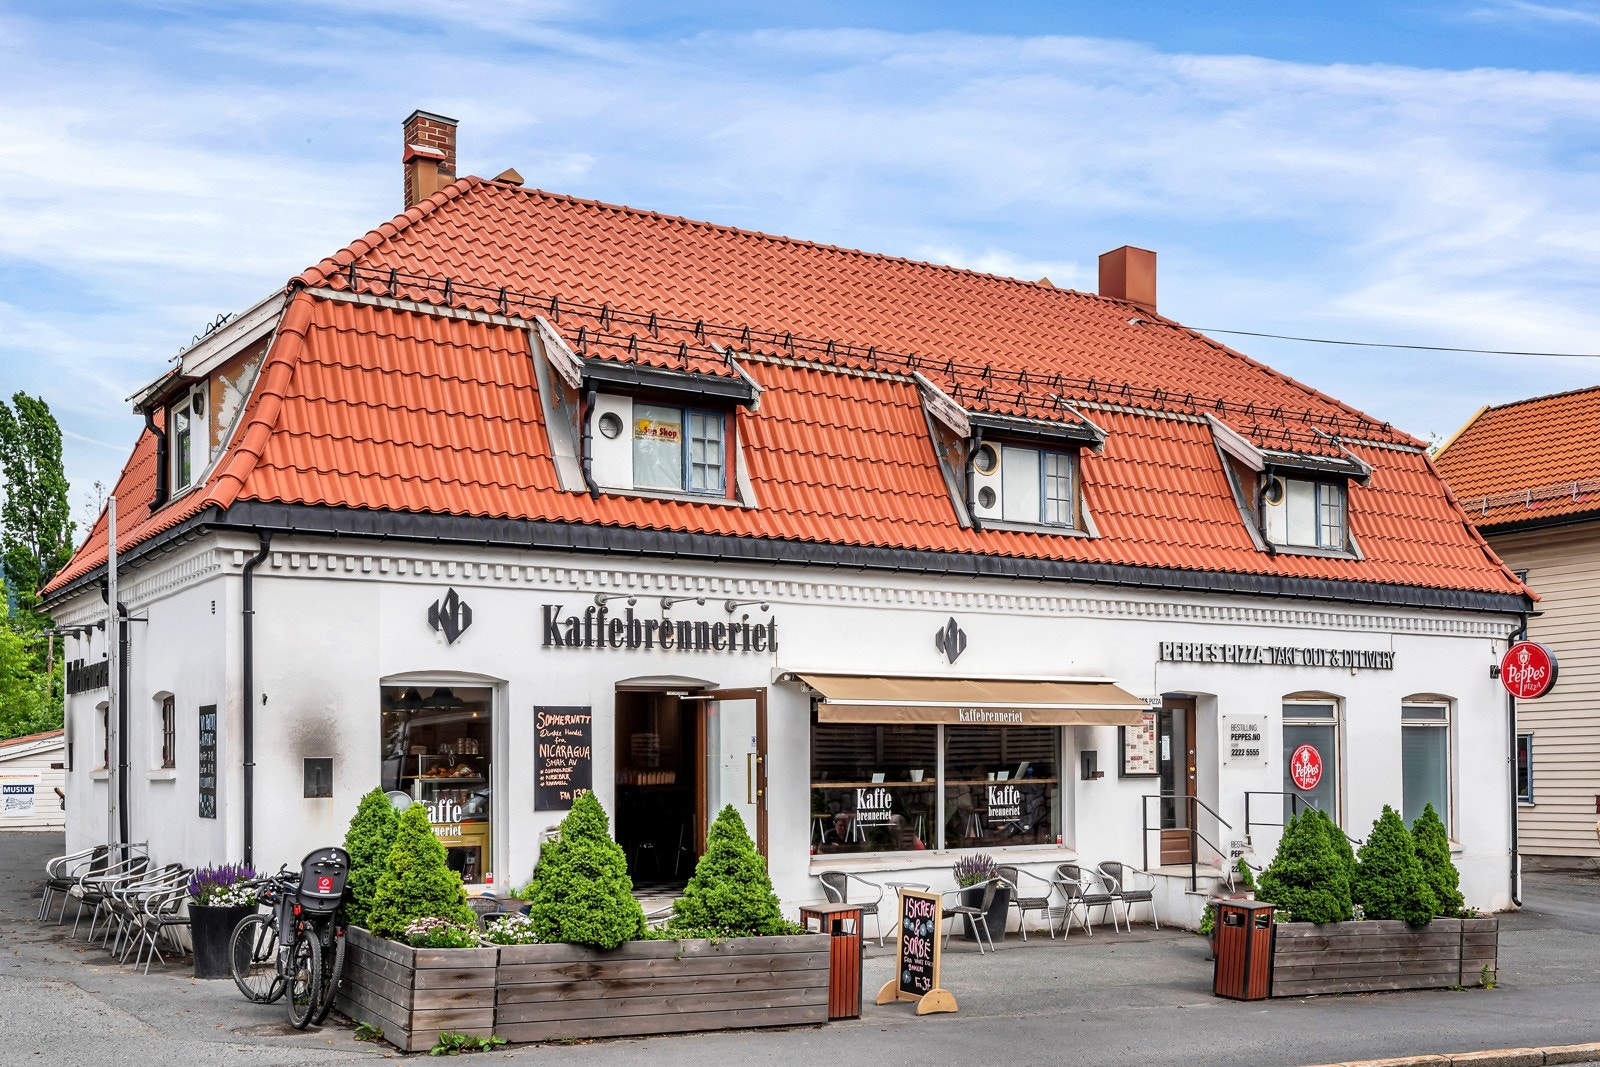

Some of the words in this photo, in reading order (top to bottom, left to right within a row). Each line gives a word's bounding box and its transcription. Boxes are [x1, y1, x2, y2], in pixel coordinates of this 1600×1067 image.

[542, 604, 778, 652] Kaffebrenneriet
[1160, 642, 1221, 663] PEPPES
[1223, 644, 1264, 664] PIZZA
[1268, 646, 1299, 665] TAKE
[1303, 647, 1328, 666] OUT
[1330, 648, 1340, 667] &
[1343, 649, 1396, 669] DELIVERY
[1507, 664, 1545, 683] Peppes
[536, 711, 592, 729] SOMMERNATT
[959, 708, 1023, 723] Kaffebrenneriet
[1231, 733, 1261, 741] PEPPES.NO
[539, 744, 590, 760] NICARAGUA
[1231, 748, 1245, 756] 2222
[1246, 748, 1260, 756] 5555
[545, 759, 566, 767] SMAK
[568, 758, 578, 766] AV
[1295, 761, 1319, 778] Peppes
[3, 786, 34, 794] MUSIKK
[856, 788, 892, 809] Kaffe
[988, 785, 1020, 805] Kaffe
[414, 799, 462, 823] affe
[857, 809, 892, 820] brenneriet
[989, 805, 1020, 817] brenneriet
[905, 898, 936, 921] ISKREM
[914, 919, 921, 936] &
